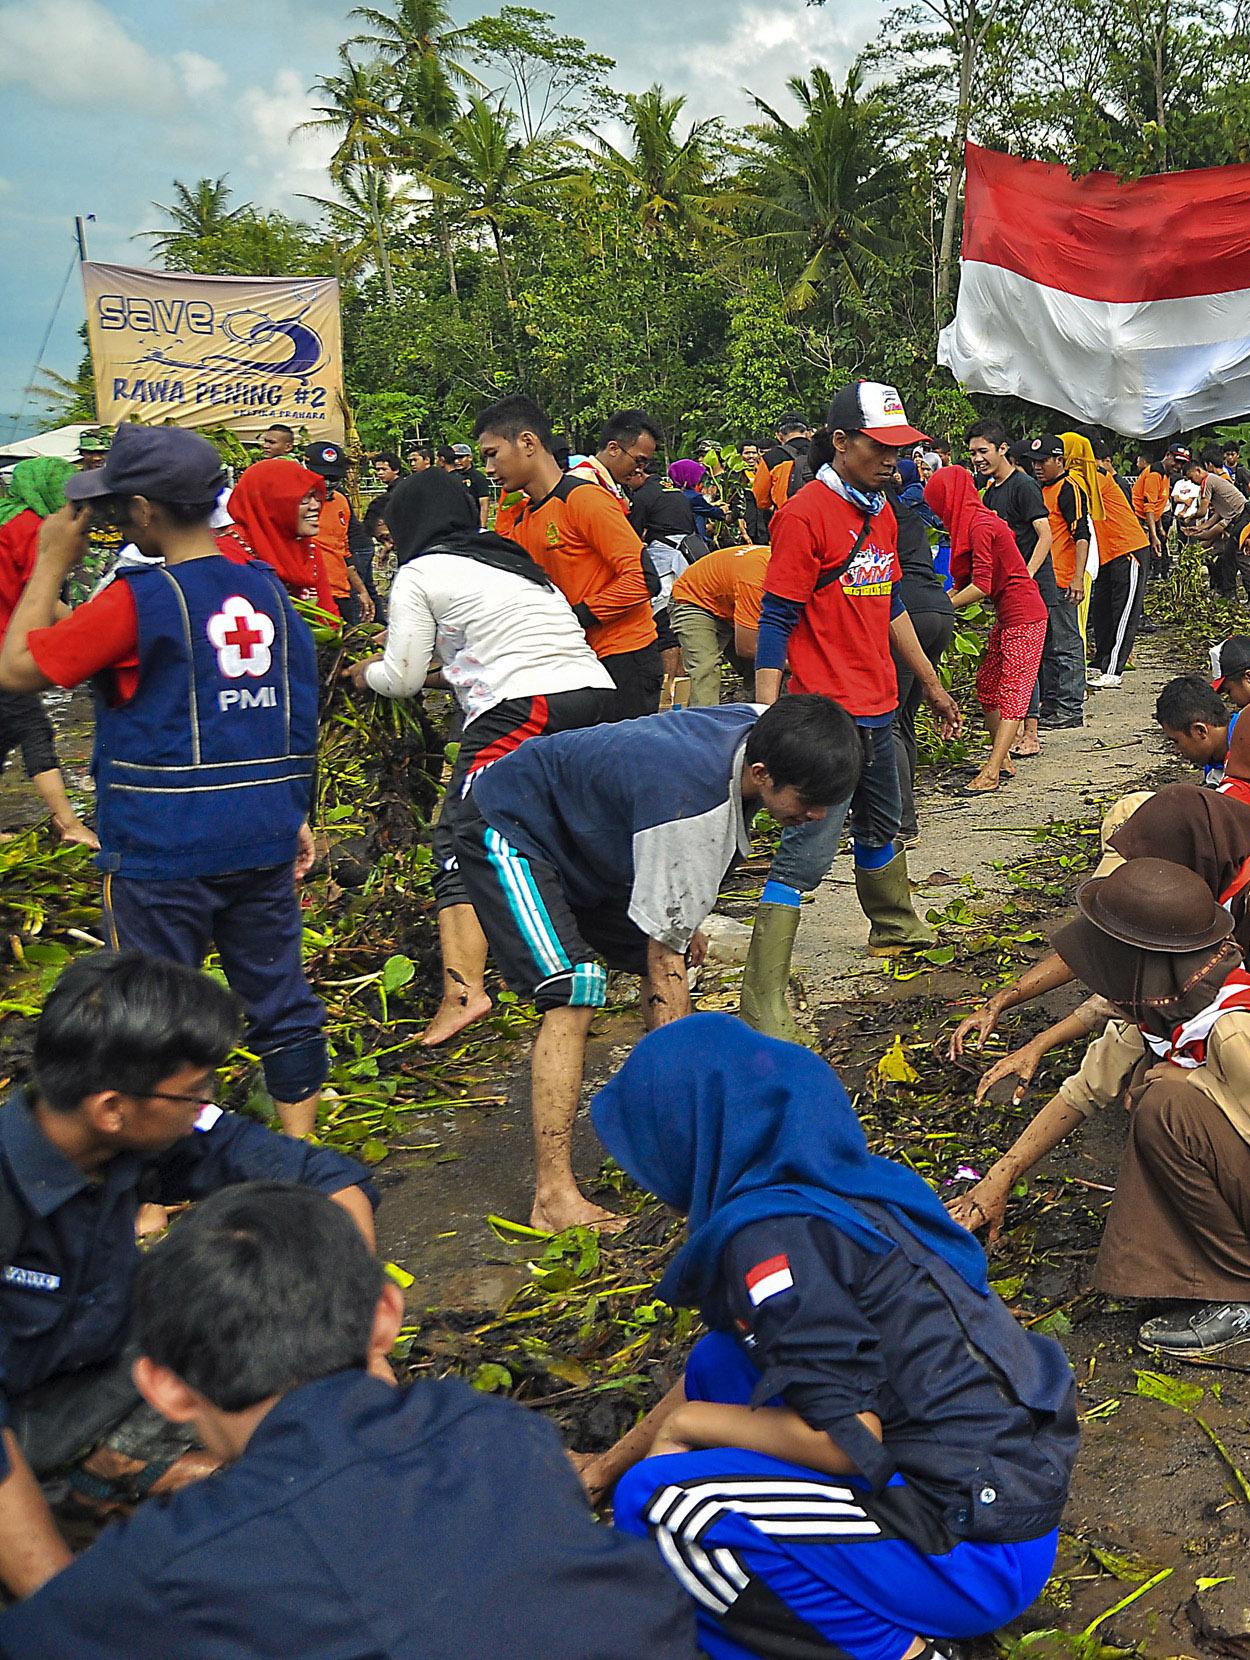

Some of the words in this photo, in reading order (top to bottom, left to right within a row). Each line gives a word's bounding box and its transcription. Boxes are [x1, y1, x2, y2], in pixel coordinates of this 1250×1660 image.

[113, 377, 186, 404] RAWA
[196, 382, 282, 406] PENING
[294, 386, 328, 408] #2
[218, 686, 277, 712] PMI
